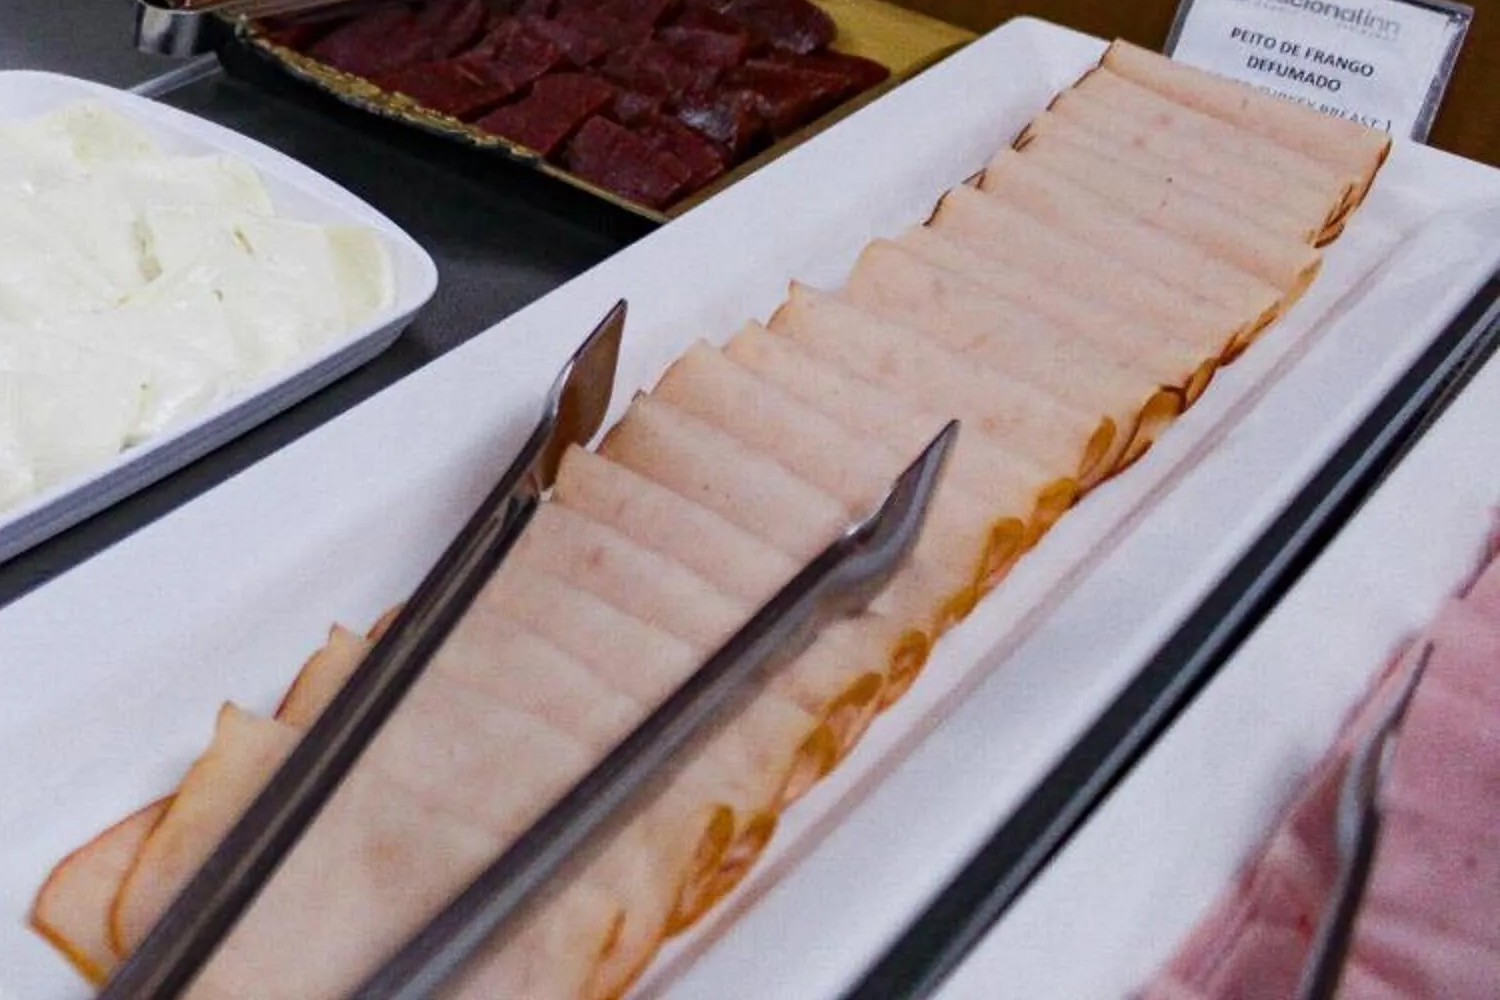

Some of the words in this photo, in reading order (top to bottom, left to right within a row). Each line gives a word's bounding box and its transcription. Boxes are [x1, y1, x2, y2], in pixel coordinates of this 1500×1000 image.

[1231, 26, 1277, 49] PEITO
[1279, 41, 1301, 56] DE
[1304, 47, 1374, 77] FRANGO
[1246, 55, 1341, 92] DEFUMADO
